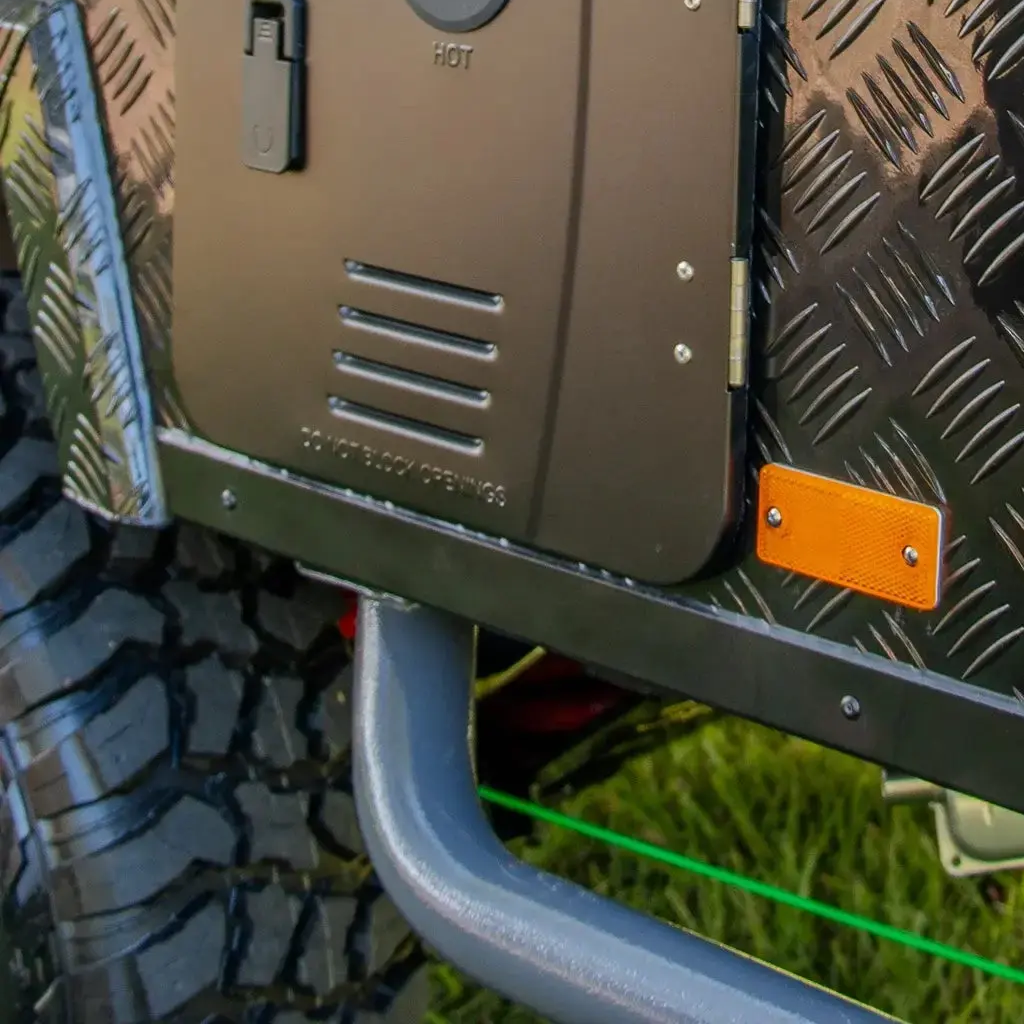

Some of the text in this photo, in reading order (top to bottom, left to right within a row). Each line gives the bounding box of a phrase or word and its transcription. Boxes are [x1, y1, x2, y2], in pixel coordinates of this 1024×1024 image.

[432, 40, 474, 71] HOT
[301, 425, 507, 508] DO NOT BLOCK OPENINGS
